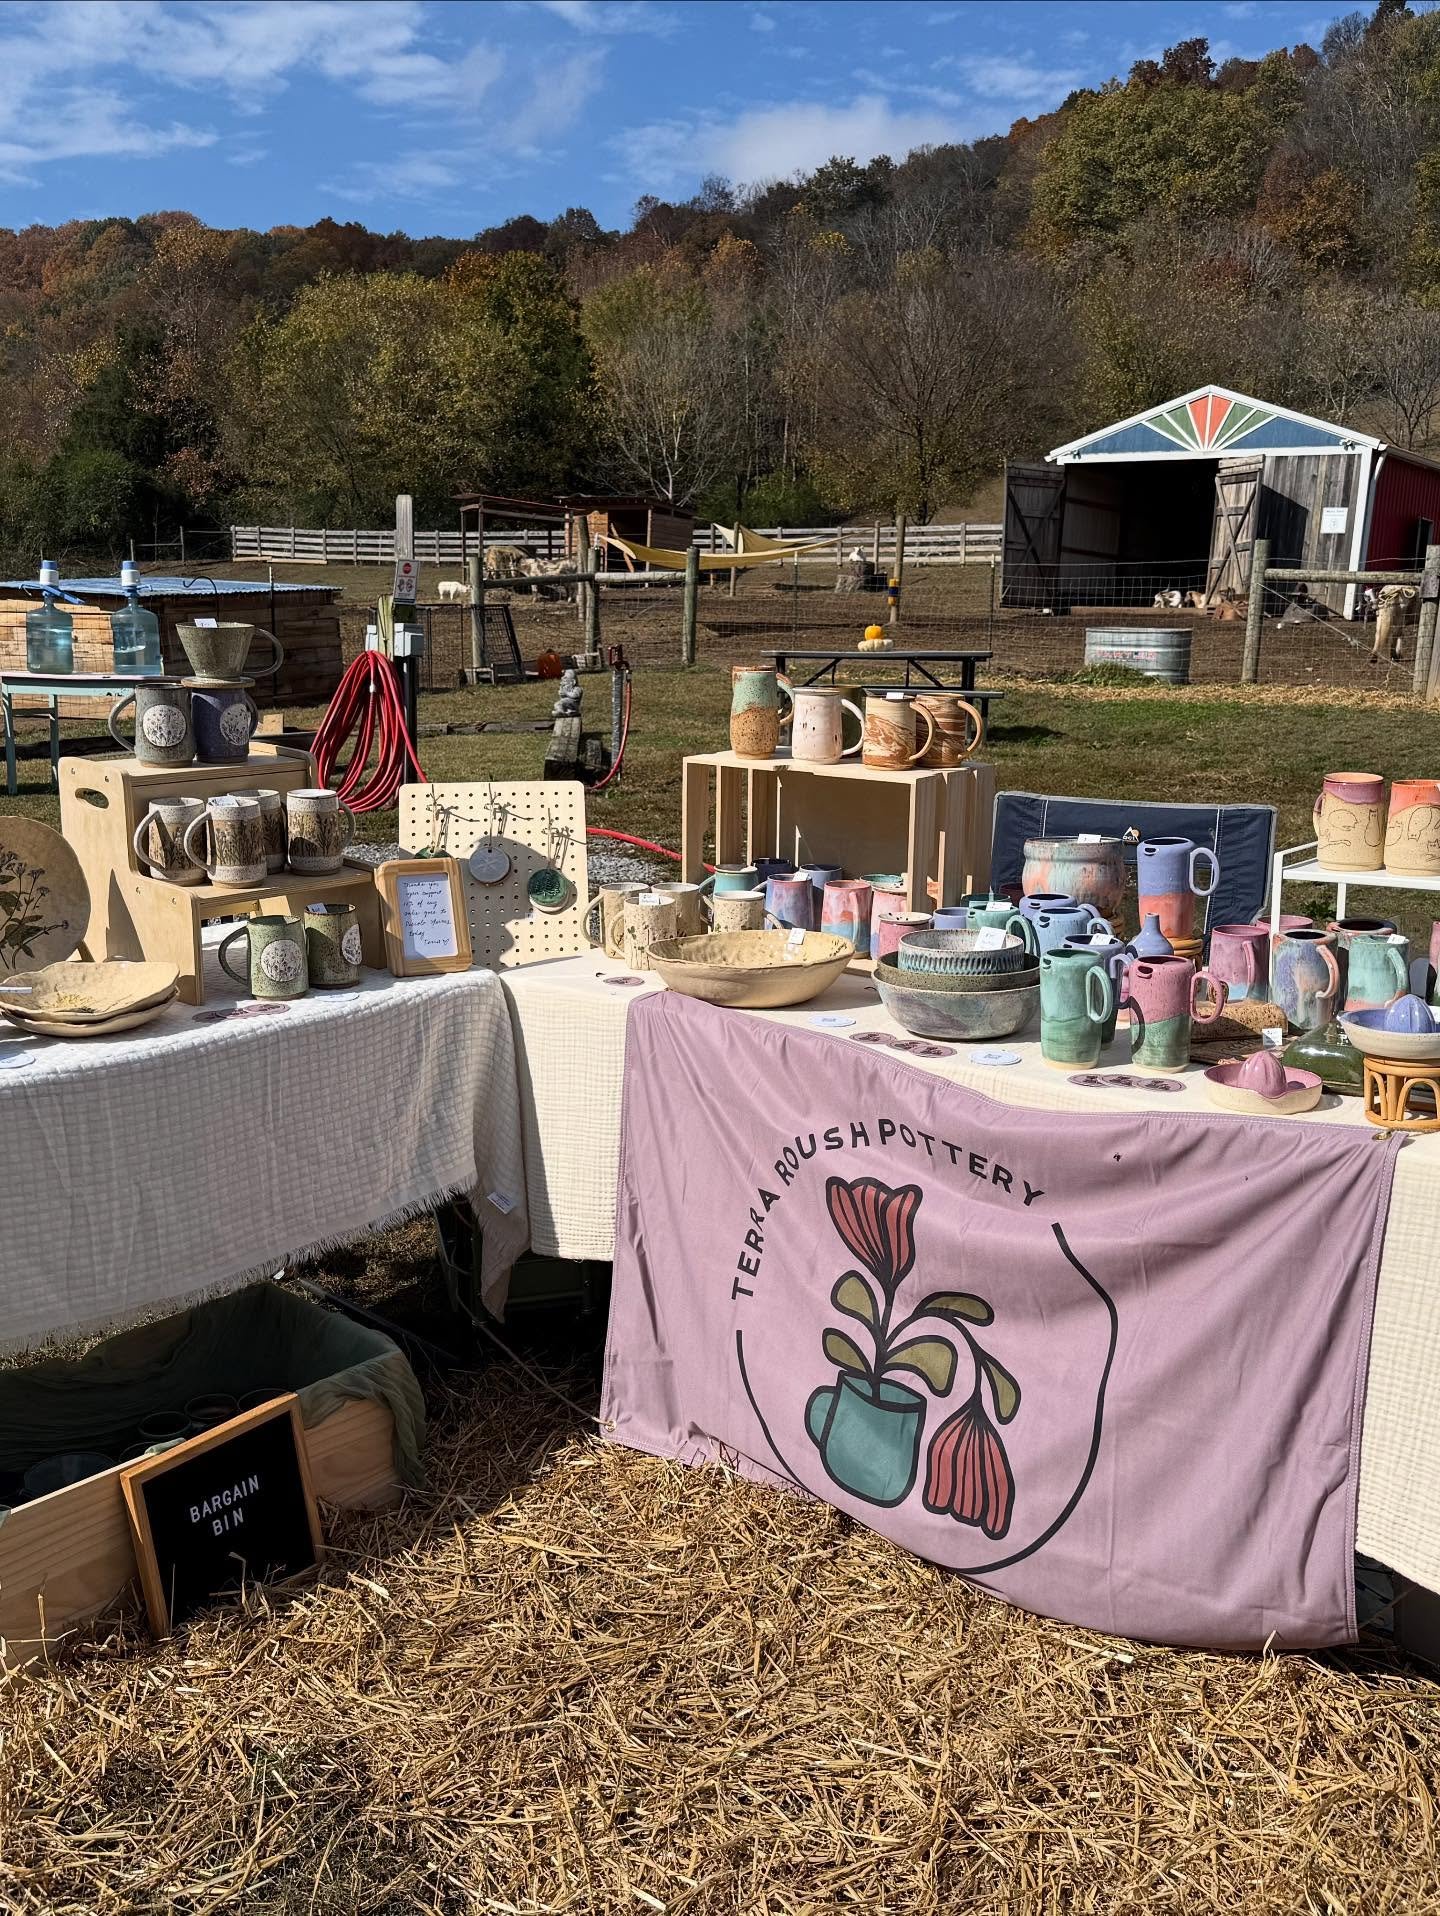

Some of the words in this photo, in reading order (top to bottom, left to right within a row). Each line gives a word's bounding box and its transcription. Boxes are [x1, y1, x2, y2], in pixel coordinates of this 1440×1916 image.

[731, 1187, 781, 1301] TERRA
[774, 1121, 870, 1187] ROUSH
[878, 1118, 1045, 1207] POTTERY
[189, 1474, 260, 1523] BARGAIN
[211, 1507, 244, 1537] BIN
